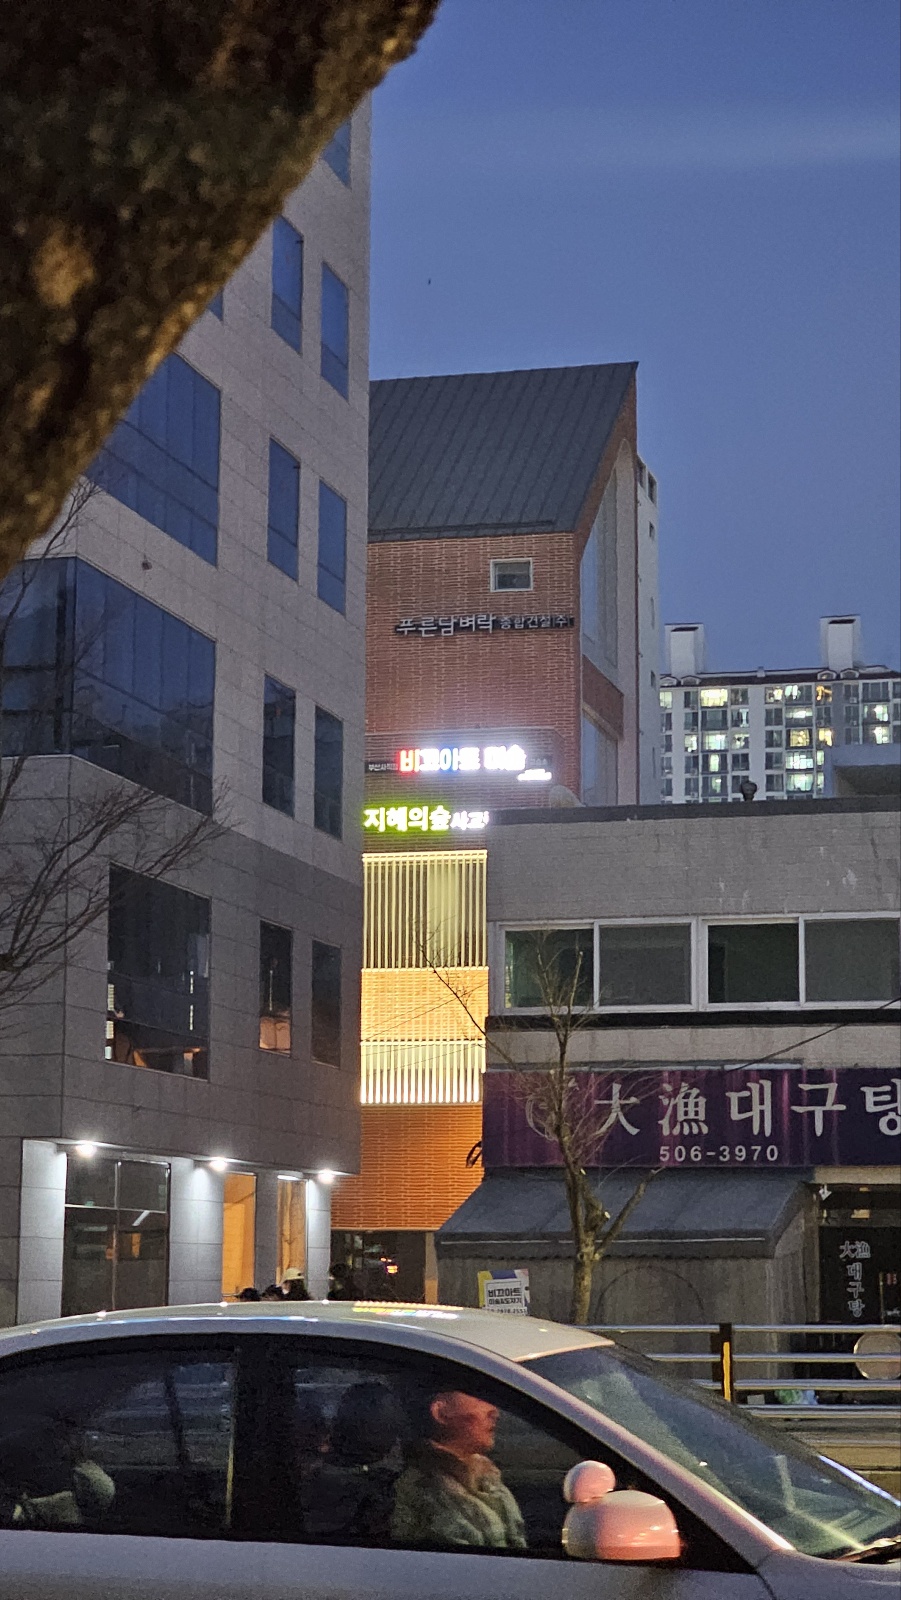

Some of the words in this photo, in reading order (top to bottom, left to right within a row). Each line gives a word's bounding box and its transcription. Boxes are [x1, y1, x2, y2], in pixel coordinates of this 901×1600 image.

[396, 613, 497, 637] 푸른담벼락
[363, 805, 451, 832] 지혜의숲
[658, 1144, 779, 1163] 506-3970
